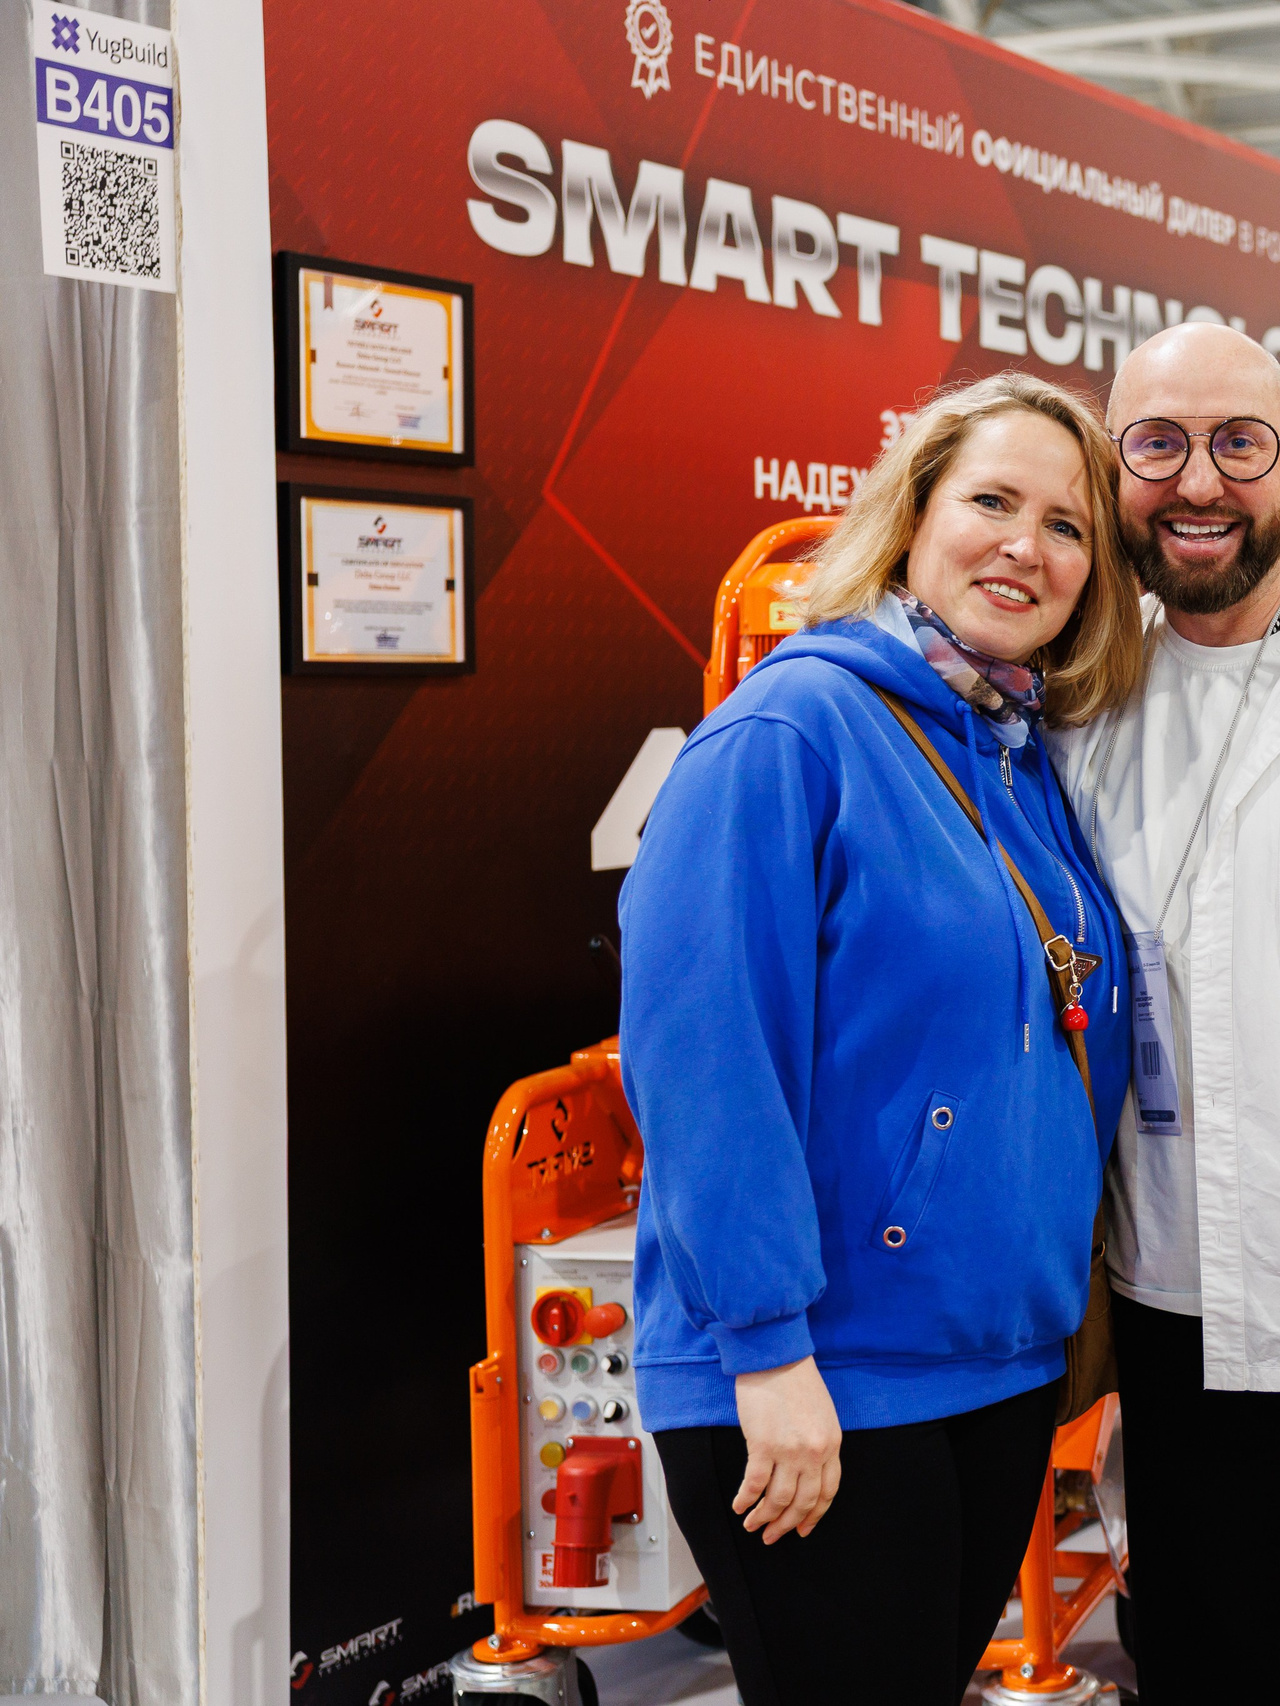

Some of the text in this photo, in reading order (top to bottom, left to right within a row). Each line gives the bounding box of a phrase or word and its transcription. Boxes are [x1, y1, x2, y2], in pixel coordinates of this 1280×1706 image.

[85, 27, 168, 69] YugBuild
[45, 66, 171, 143] B405
[694, 32, 965, 158] ЕДИНСТВЕННЫЙ
[971, 129, 1164, 224] ОФИЦИАЛЬНЫЙ
[1167, 195, 1236, 246] ДИЛЕР
[1238, 220, 1254, 253] В
[466, 118, 900, 326] SMART
[318, 1617, 403, 1670] SMART
